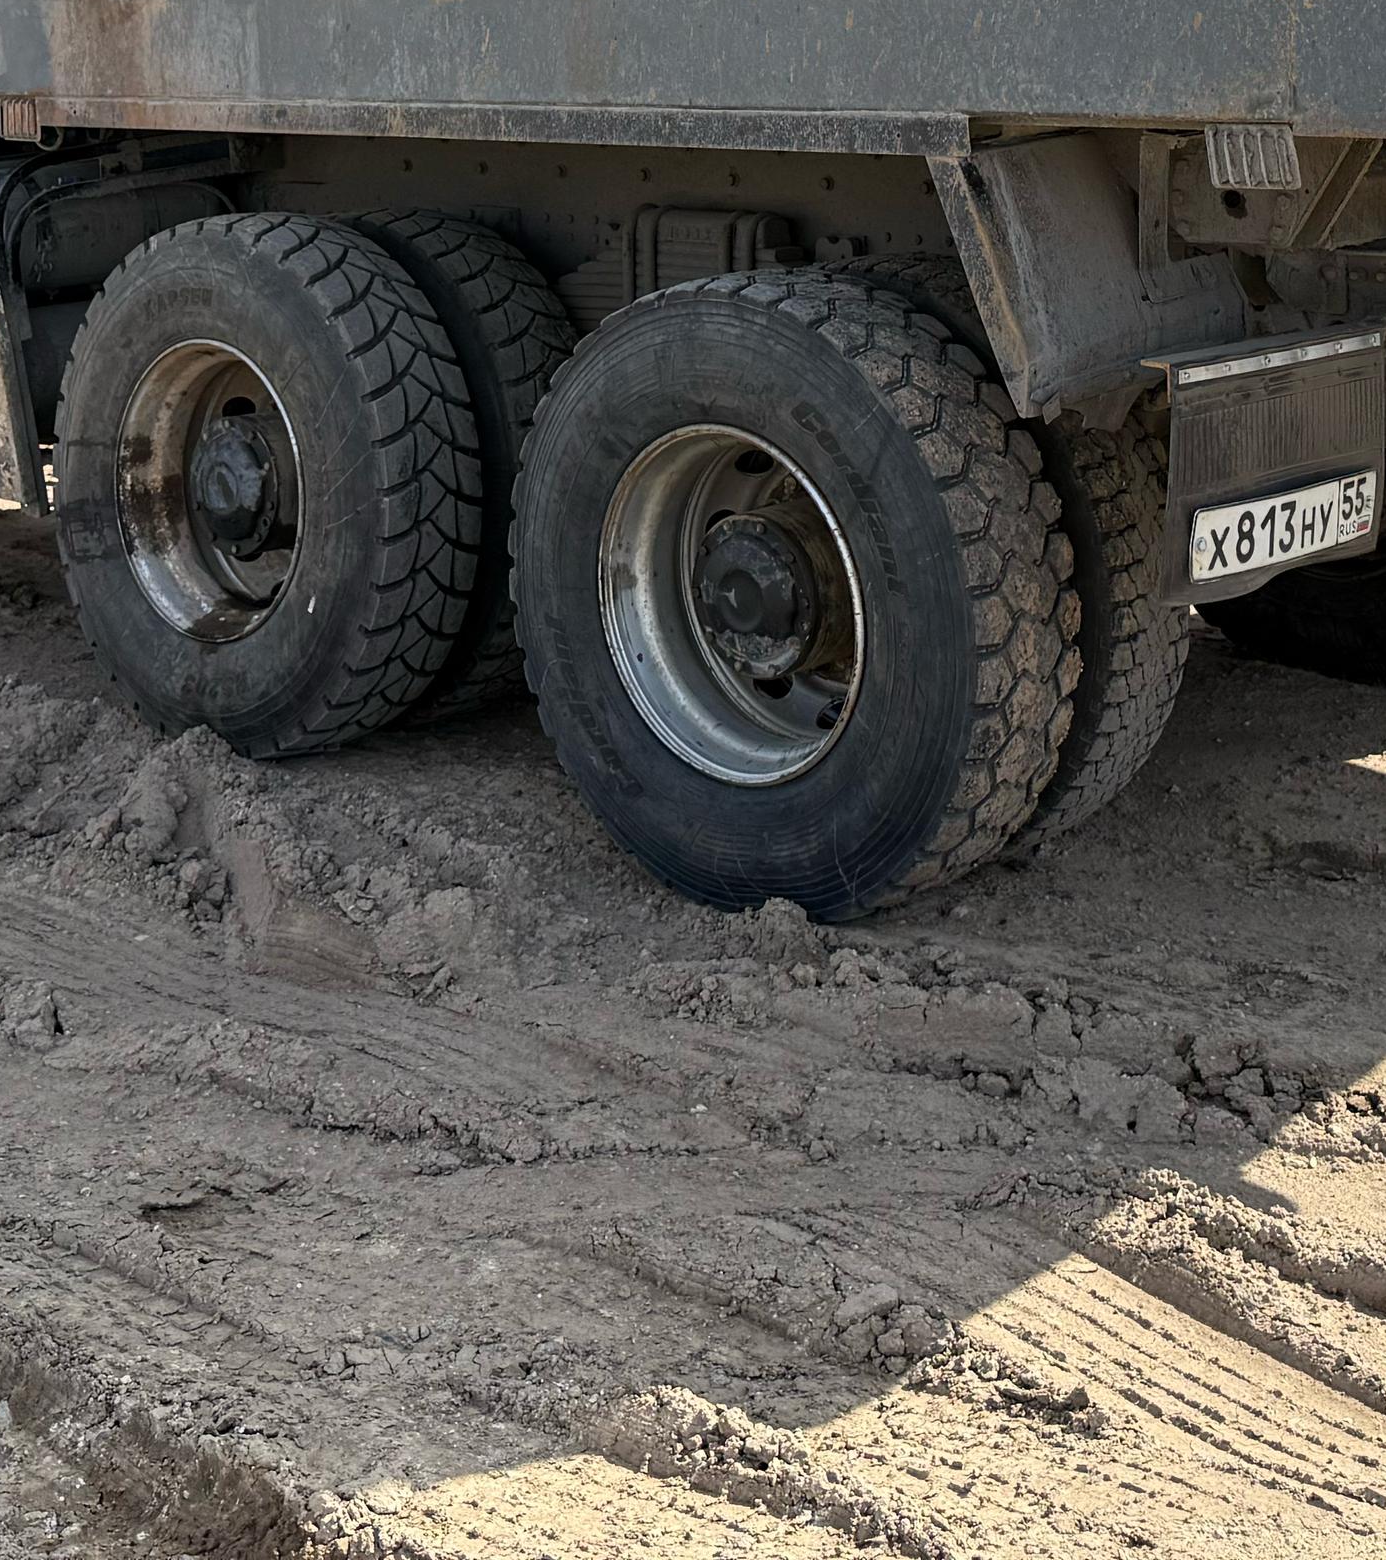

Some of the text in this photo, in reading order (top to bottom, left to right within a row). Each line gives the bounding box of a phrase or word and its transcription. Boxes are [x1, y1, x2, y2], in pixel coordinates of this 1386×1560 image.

[790, 400, 910, 597] Cordiant
[1342, 476, 1367, 520] 55
[1339, 520, 1357, 537] RUS
